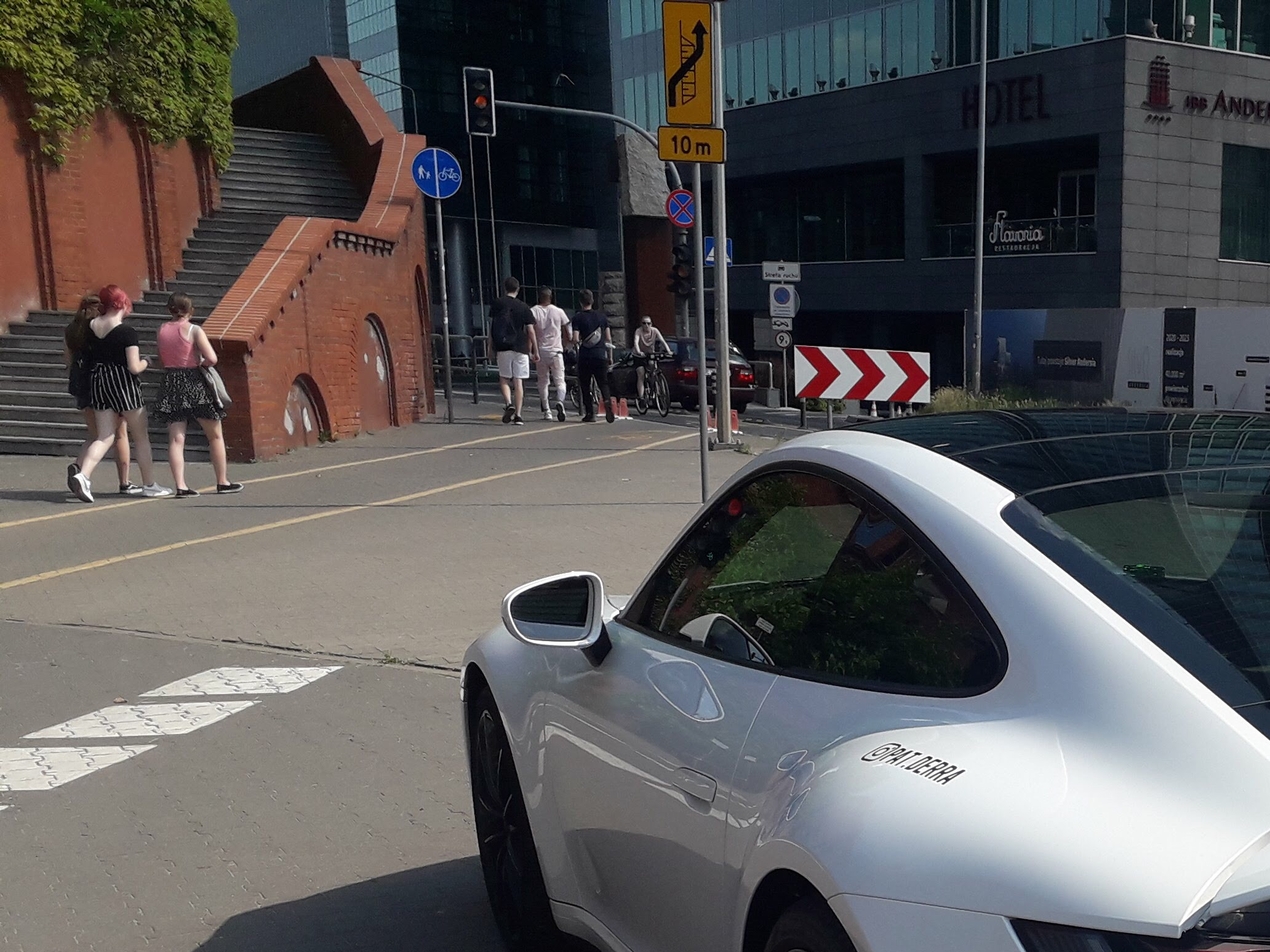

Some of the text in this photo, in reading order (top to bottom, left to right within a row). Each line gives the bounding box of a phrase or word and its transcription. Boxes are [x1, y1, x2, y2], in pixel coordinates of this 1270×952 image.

[962, 74, 1050, 130] HOTEL
[671, 135, 711, 156] 10 m
[861, 742, 966, 785] @PAT.DERRA
